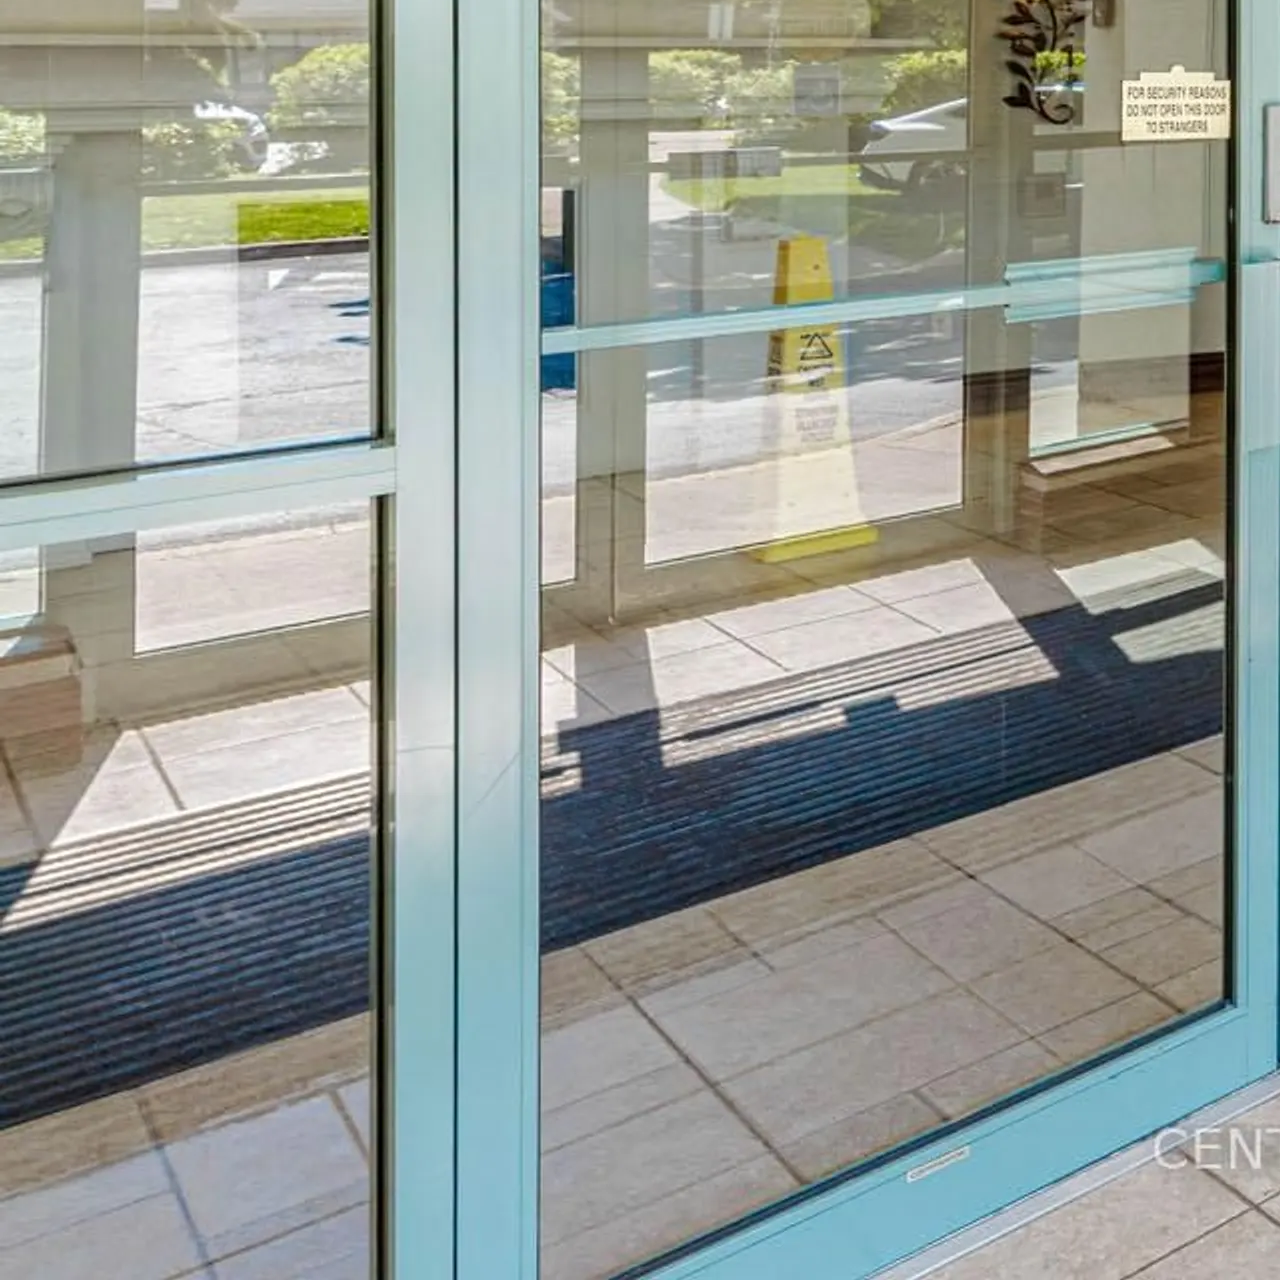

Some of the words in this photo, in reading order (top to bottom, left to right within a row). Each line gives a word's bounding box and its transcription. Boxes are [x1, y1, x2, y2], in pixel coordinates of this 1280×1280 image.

[1128, 86, 1145, 100] FOR
[1147, 86, 1186, 99] SECURITY
[1188, 86, 1227, 99] REASONS
[1127, 104, 1139, 117] DO
[1140, 104, 1158, 117] NOT
[1160, 104, 1183, 116] OPEN
[1184, 104, 1202, 116] THIS
[1204, 104, 1227, 115] DOOR
[1146, 121, 1157, 133] TO
[1159, 120, 1208, 133] STRANGERS
